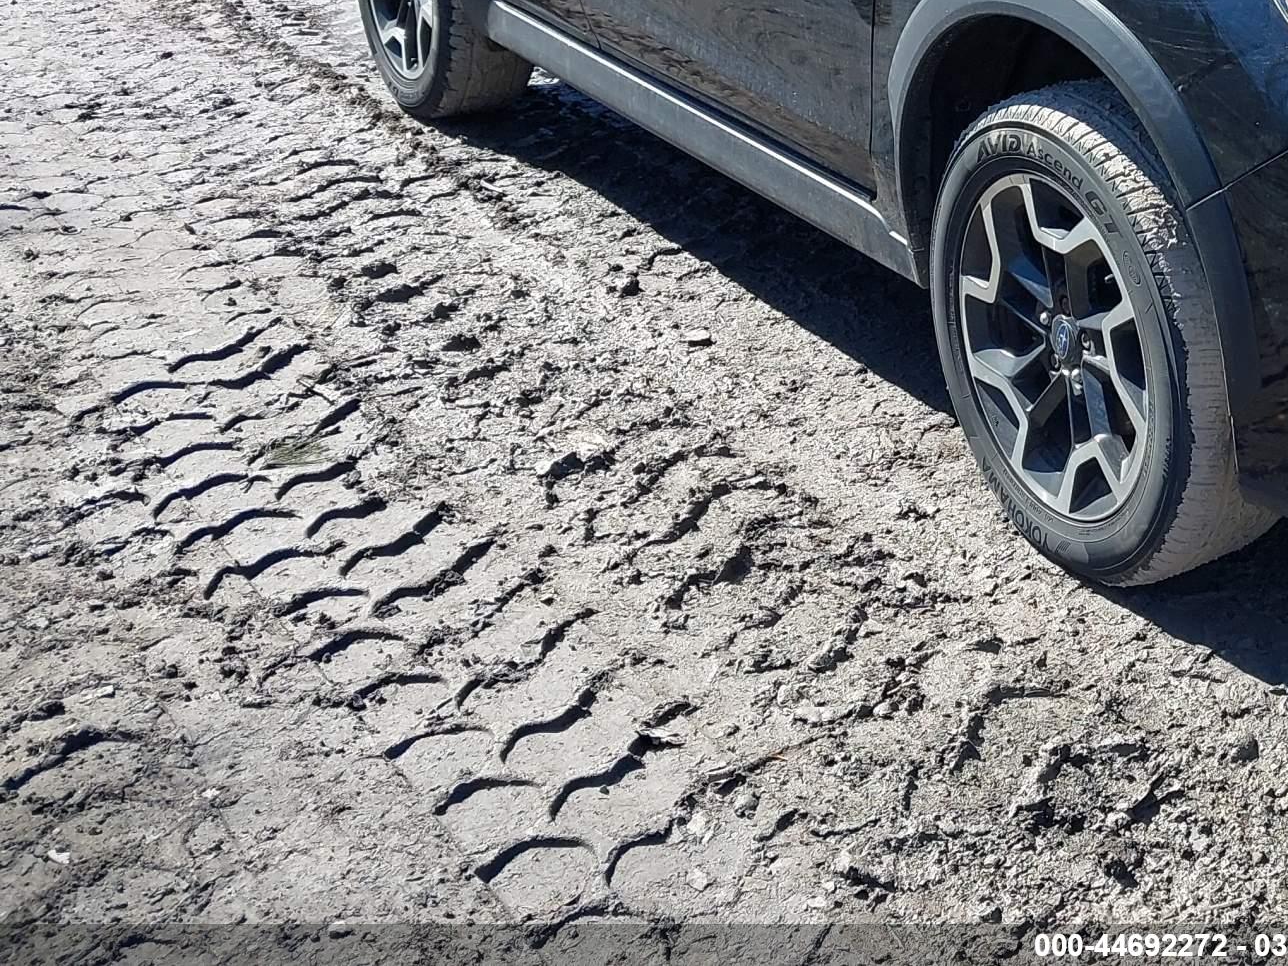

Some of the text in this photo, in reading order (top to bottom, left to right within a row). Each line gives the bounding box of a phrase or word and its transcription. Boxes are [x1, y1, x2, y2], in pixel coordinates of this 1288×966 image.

[976, 133, 1022, 163] AVID
[1084, 190, 1124, 238] GT
[979, 455, 1056, 554] YOKOHAMA
